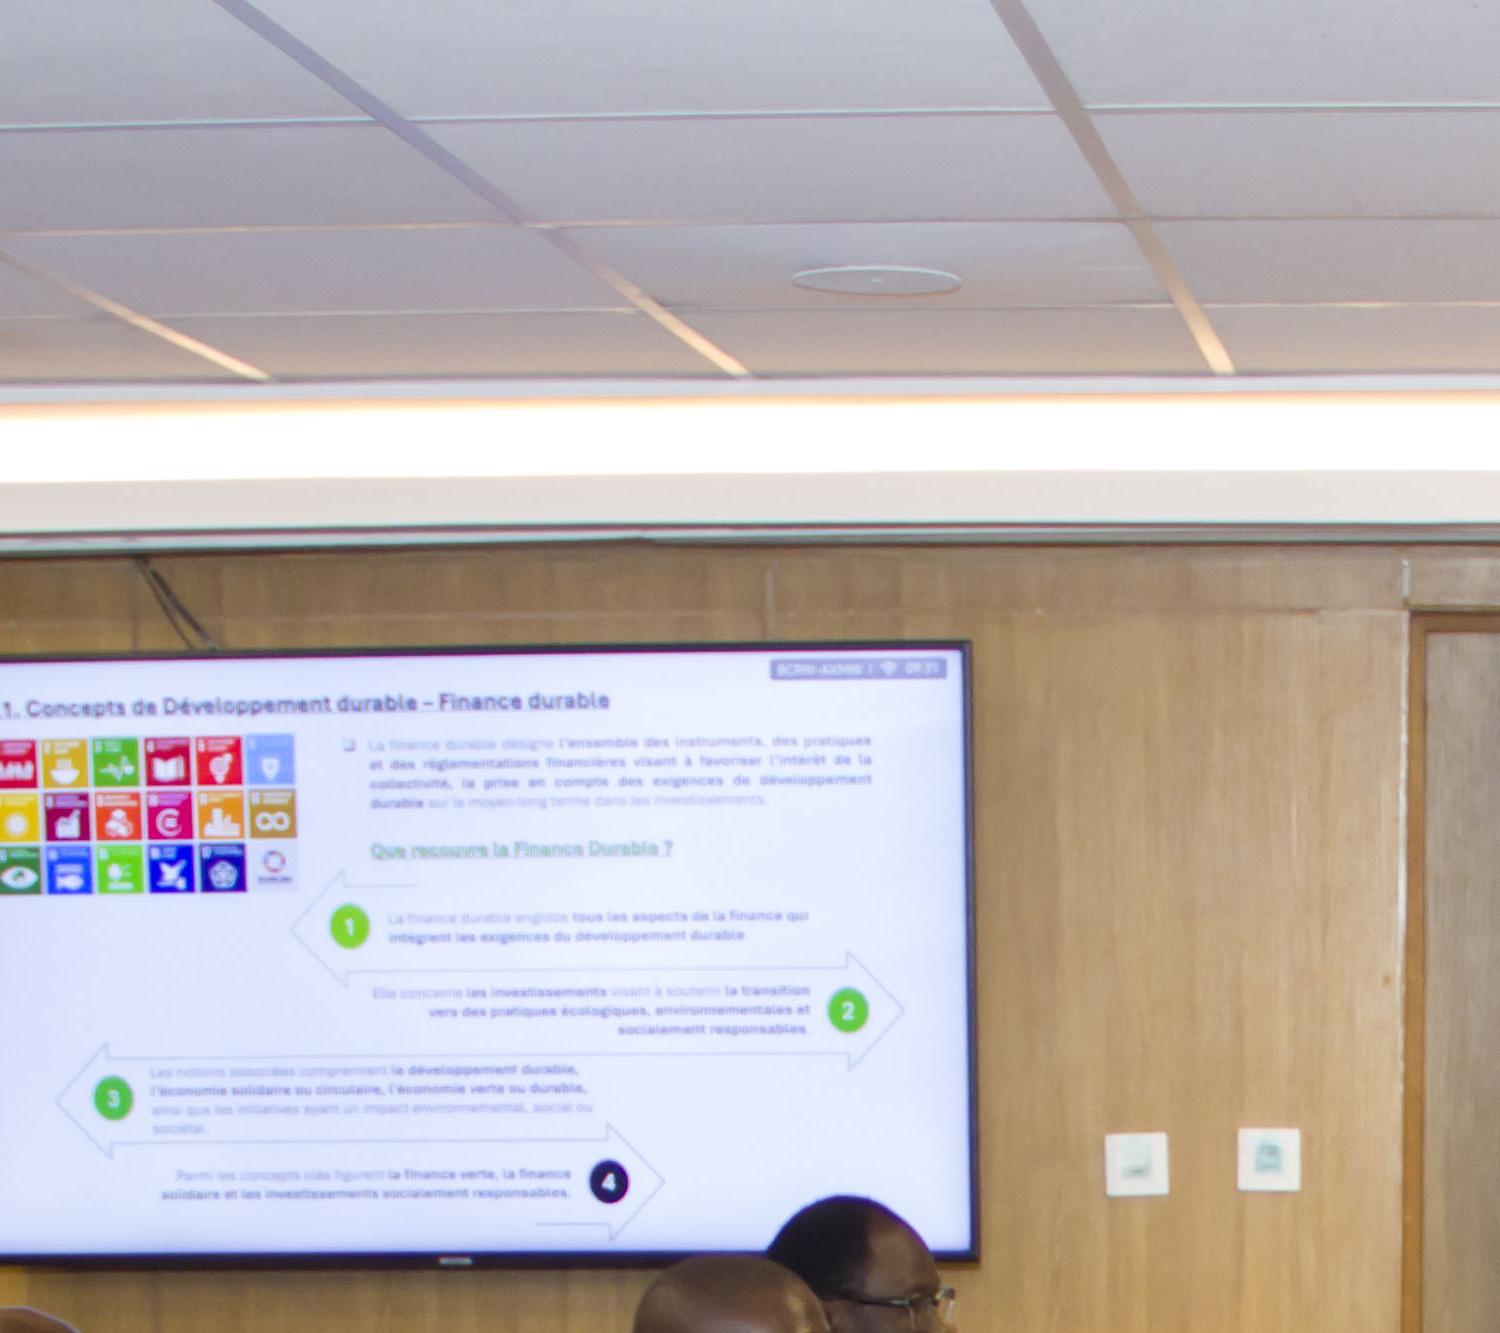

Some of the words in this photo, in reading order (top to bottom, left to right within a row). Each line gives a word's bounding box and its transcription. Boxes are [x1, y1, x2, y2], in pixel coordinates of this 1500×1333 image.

[26, 699, 126, 719] Concepts
[132, 699, 157, 717] de
[163, 697, 333, 717] Développement
[338, 694, 417, 713] durable
[440, 692, 522, 712] Finance
[528, 692, 610, 711] durable
[344, 916, 355, 937] 1
[841, 1001, 856, 1021] 2
[602, 1173, 616, 1190] 4
